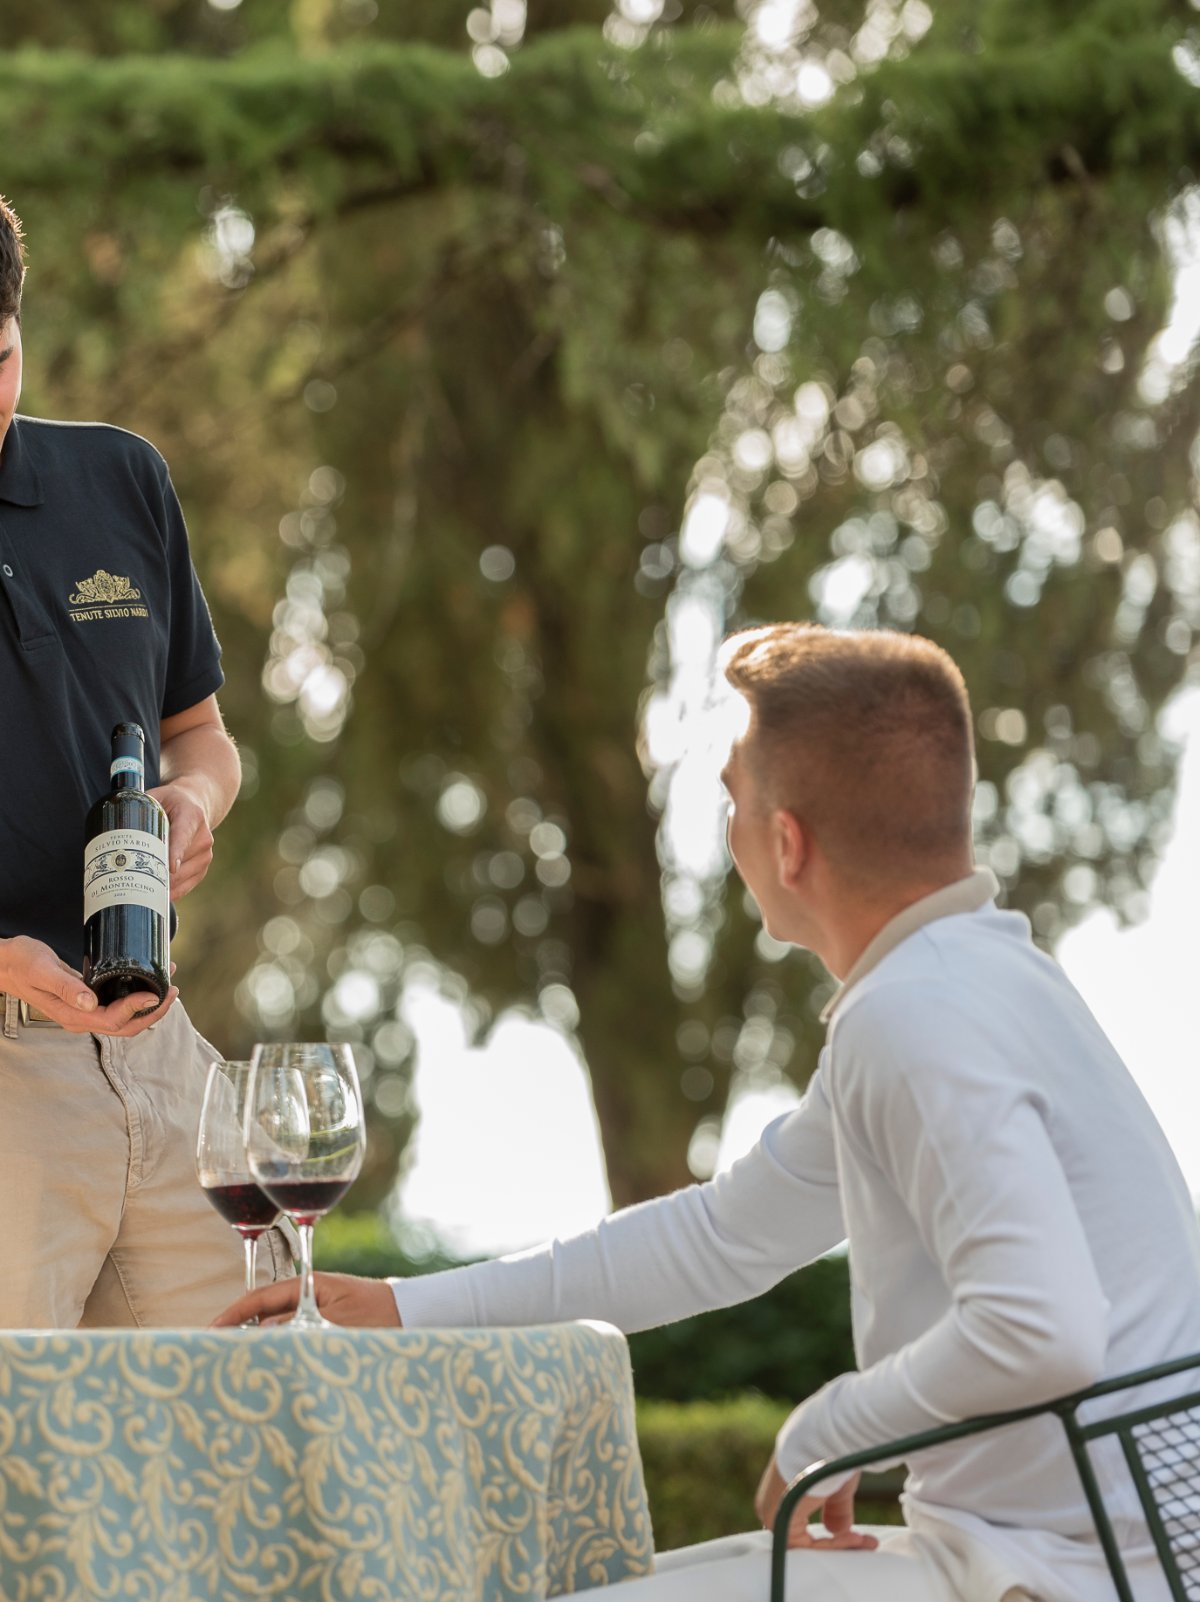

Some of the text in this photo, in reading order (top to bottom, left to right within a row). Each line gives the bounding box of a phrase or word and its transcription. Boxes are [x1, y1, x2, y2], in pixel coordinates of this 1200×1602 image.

[69, 607, 149, 622] TENUTE SILVIO NARDI
[95, 839, 150, 852] SILVIO NARDI
[108, 875, 134, 883] ROSSO
[100, 882, 155, 893] MONTALCINO
